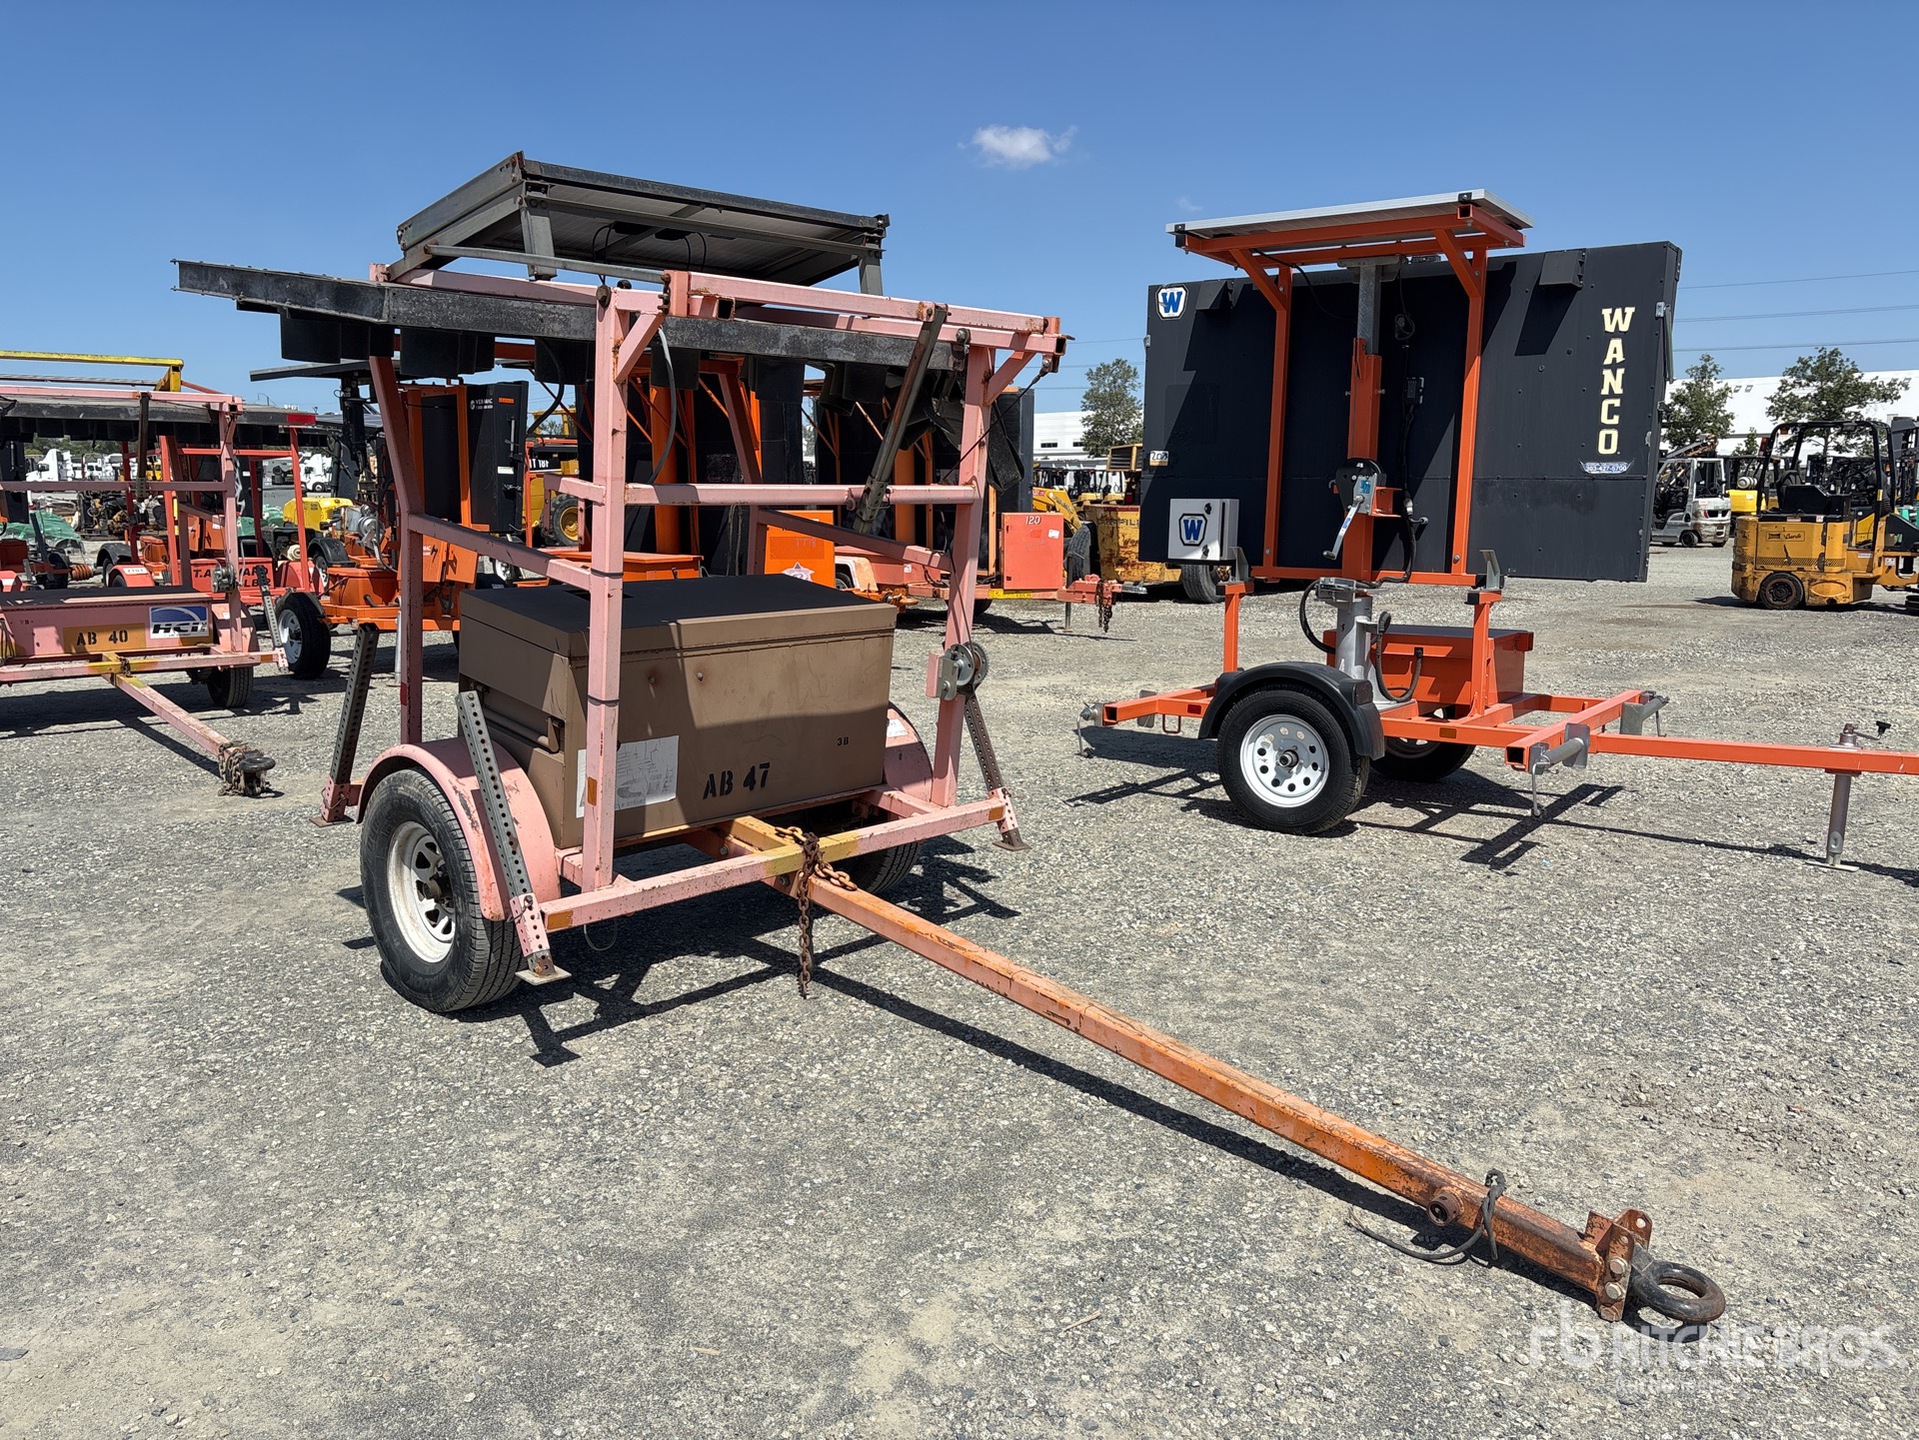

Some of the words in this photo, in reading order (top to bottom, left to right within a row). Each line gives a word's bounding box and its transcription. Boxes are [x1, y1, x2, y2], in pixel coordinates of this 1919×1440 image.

[1598, 306, 1636, 455] WANCO
[1025, 515, 1042, 525] 120
[76, 631, 98, 647] AB
[108, 629, 129, 645] 40
[837, 736, 849, 747] 3B
[702, 770, 734, 800] AB
[742, 762, 771, 792] 47
